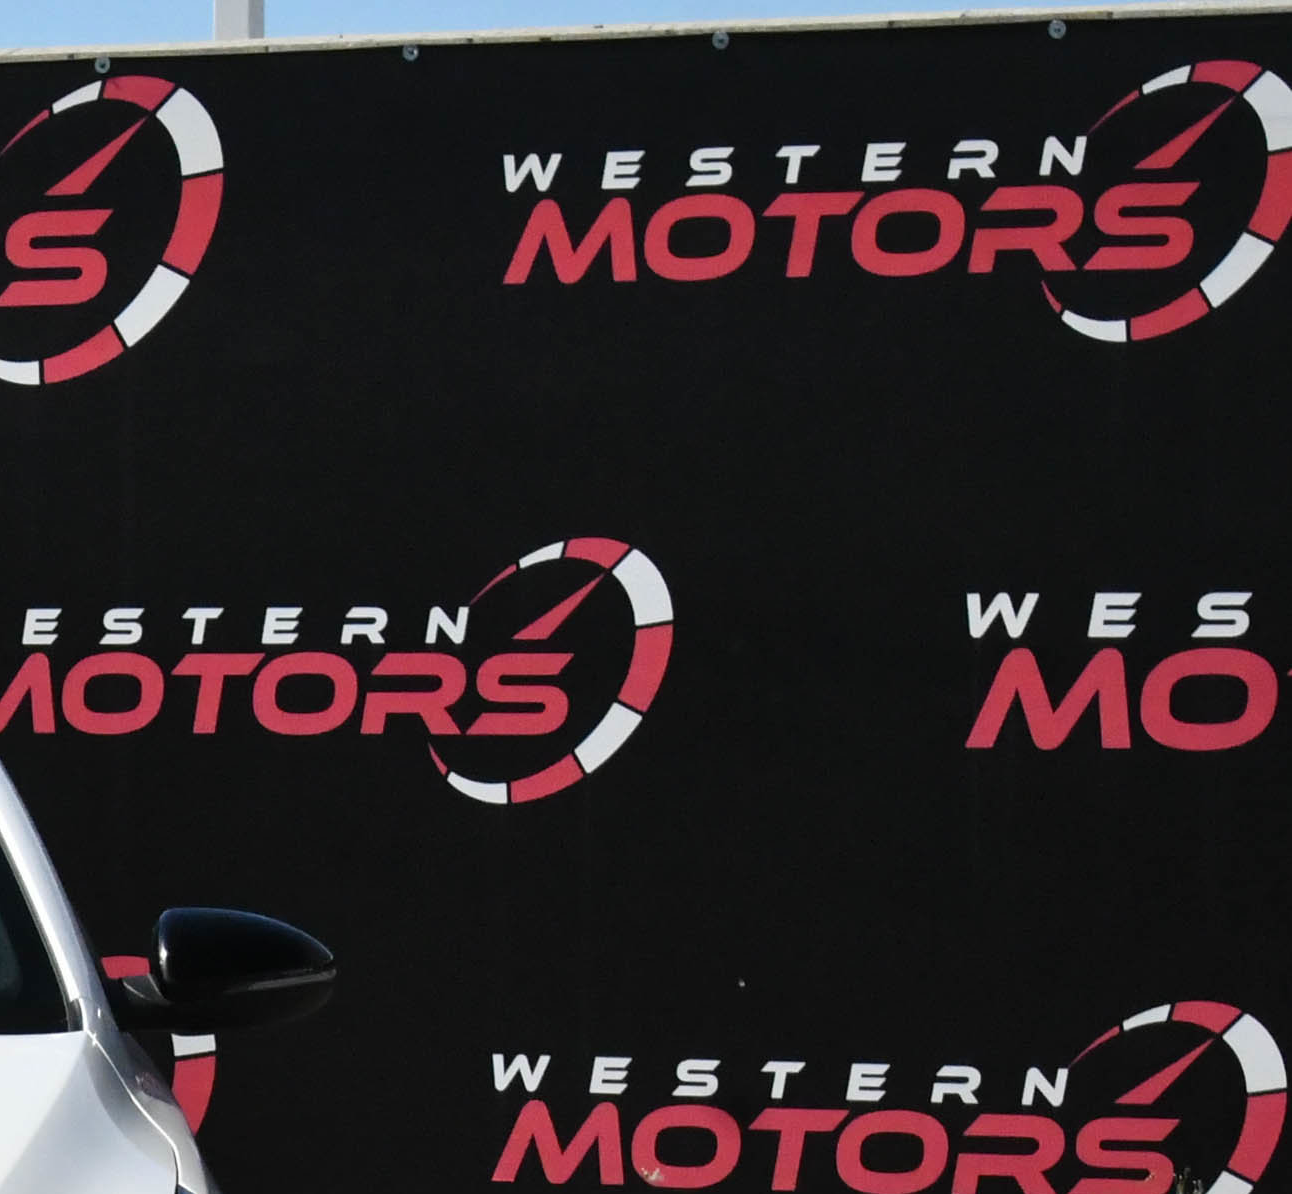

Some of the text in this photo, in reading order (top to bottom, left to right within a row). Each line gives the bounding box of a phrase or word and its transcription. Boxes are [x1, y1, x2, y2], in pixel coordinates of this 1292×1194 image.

[503, 135, 1089, 193] WESTERN
[502, 181, 1201, 286] MOTORS
[966, 591, 1254, 639] WES
[964, 647, 1292, 752] MO
[491, 1053, 1070, 1107] WESTERN
